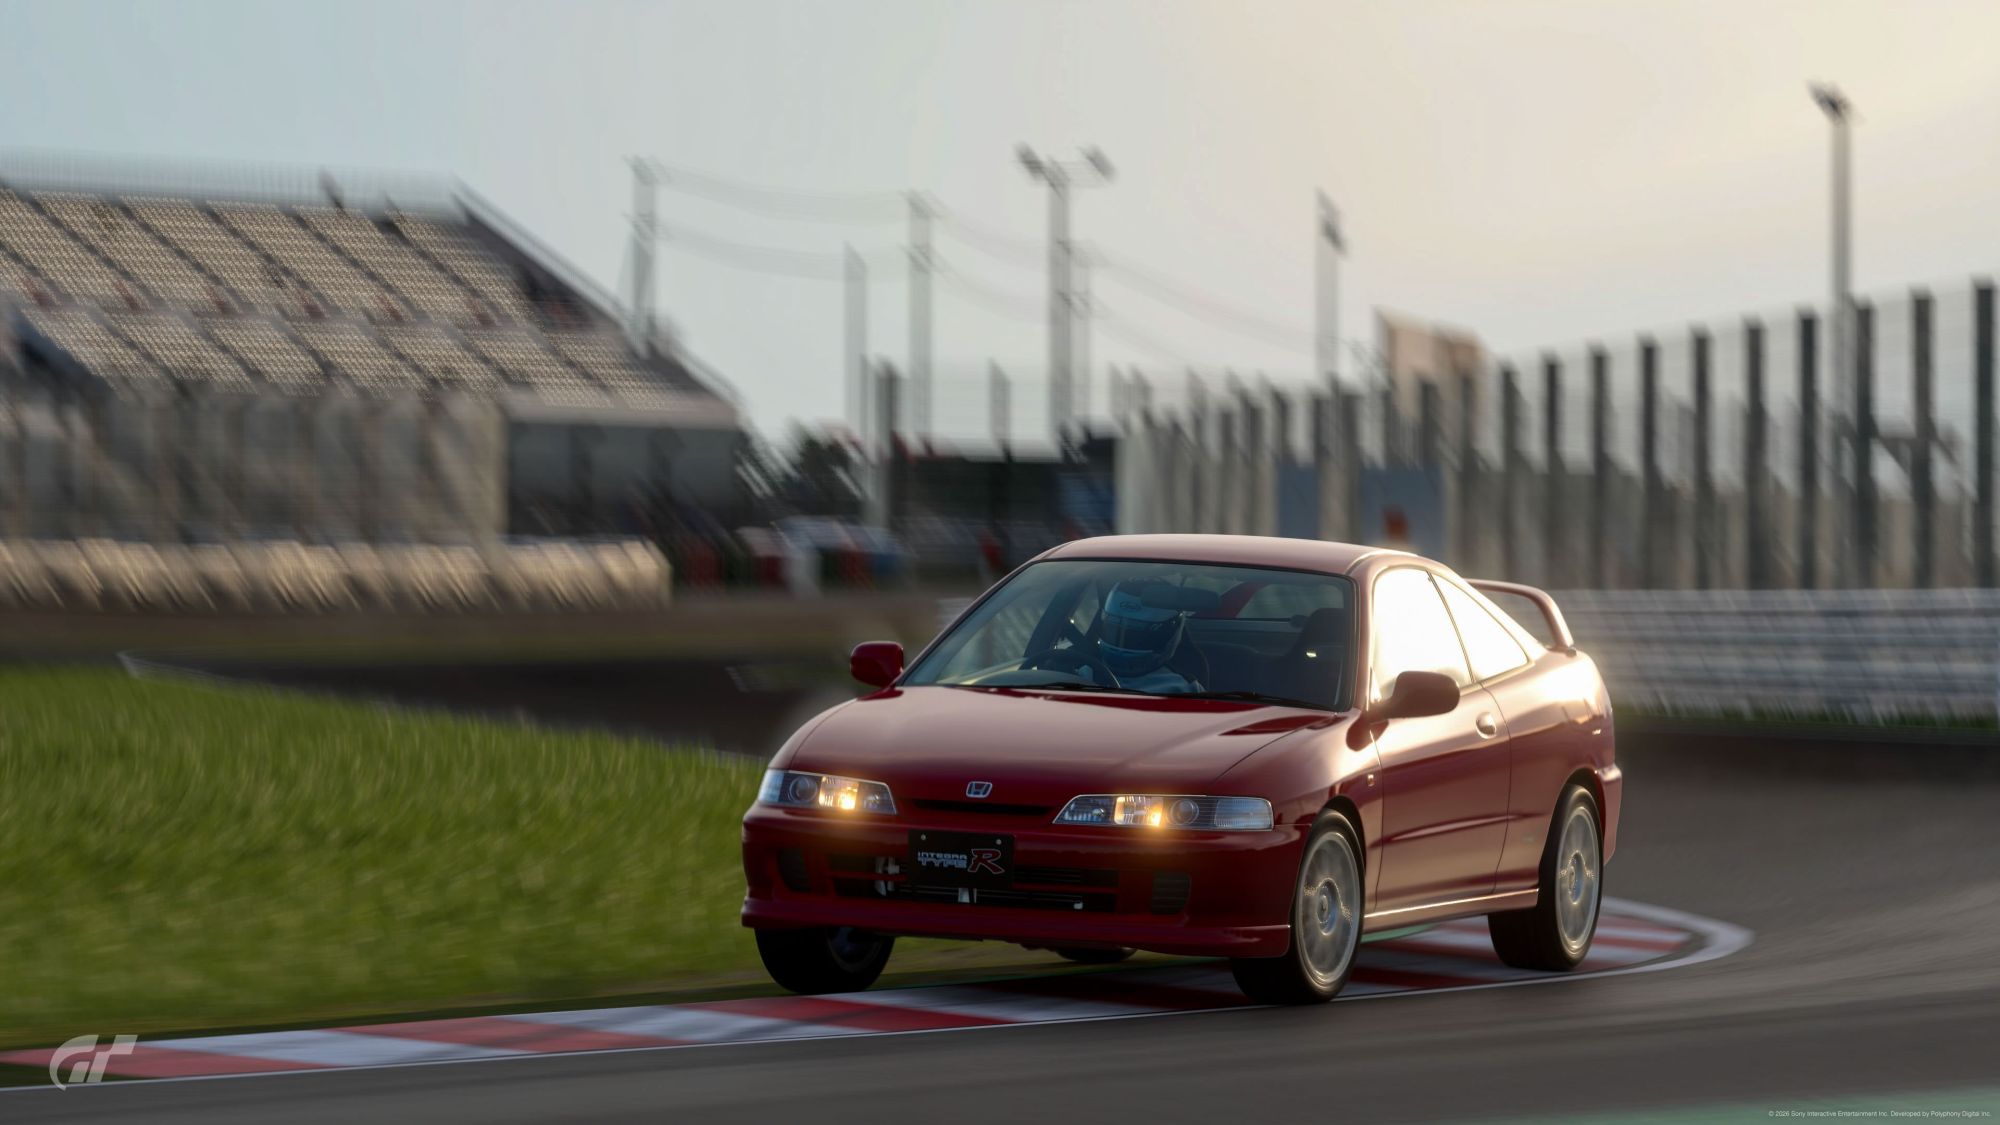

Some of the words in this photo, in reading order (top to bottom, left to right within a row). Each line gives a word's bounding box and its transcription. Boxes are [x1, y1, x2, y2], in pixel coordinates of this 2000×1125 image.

[917, 851, 968, 860] INTEGRA
[917, 858, 968, 869] TYPE
[967, 848, 1005, 875] R
